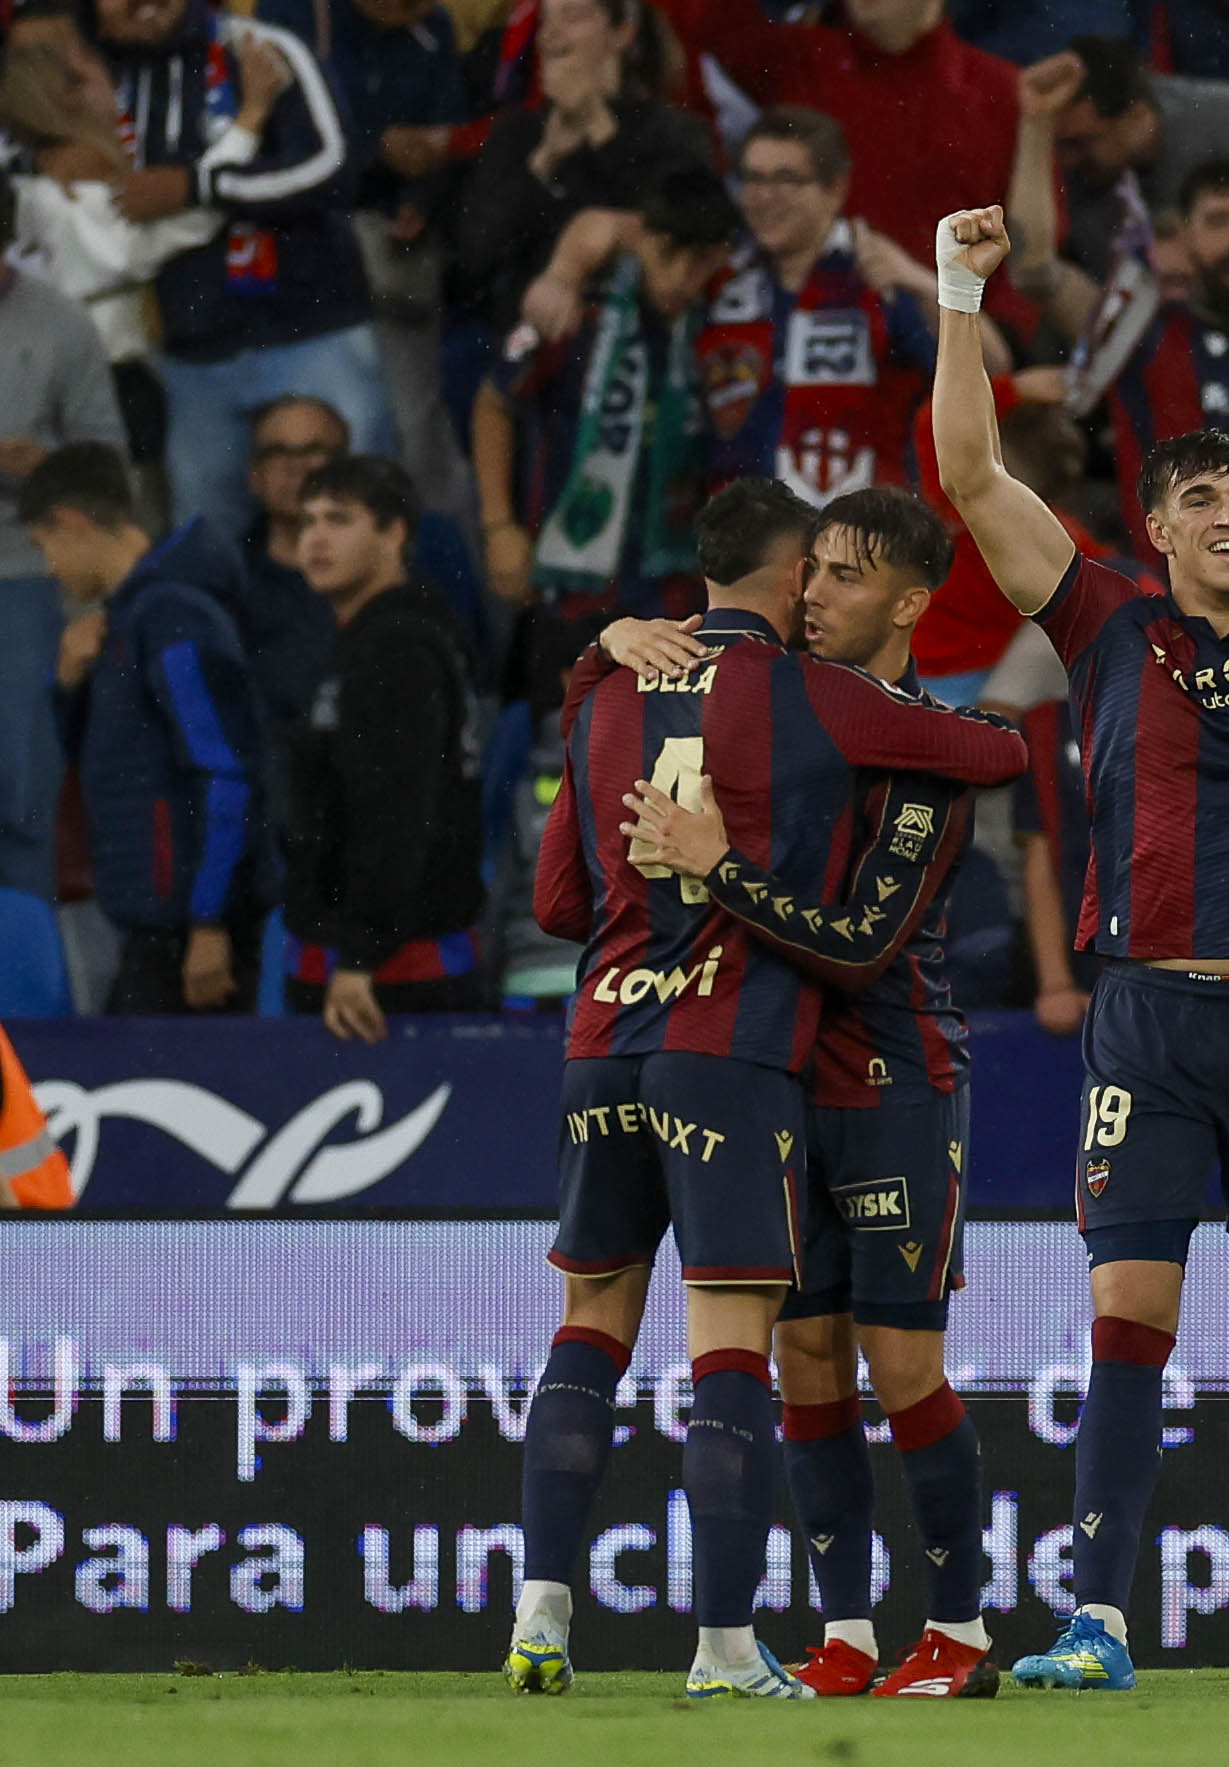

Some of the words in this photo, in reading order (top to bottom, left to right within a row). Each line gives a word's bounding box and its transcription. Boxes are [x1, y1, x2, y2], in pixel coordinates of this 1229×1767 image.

[629, 736, 710, 904] 4
[1084, 1085, 1132, 1151] 19
[0, 1333, 178, 1443] Un
[0, 1500, 304, 1613] Para
[357, 1523, 525, 1613] un
